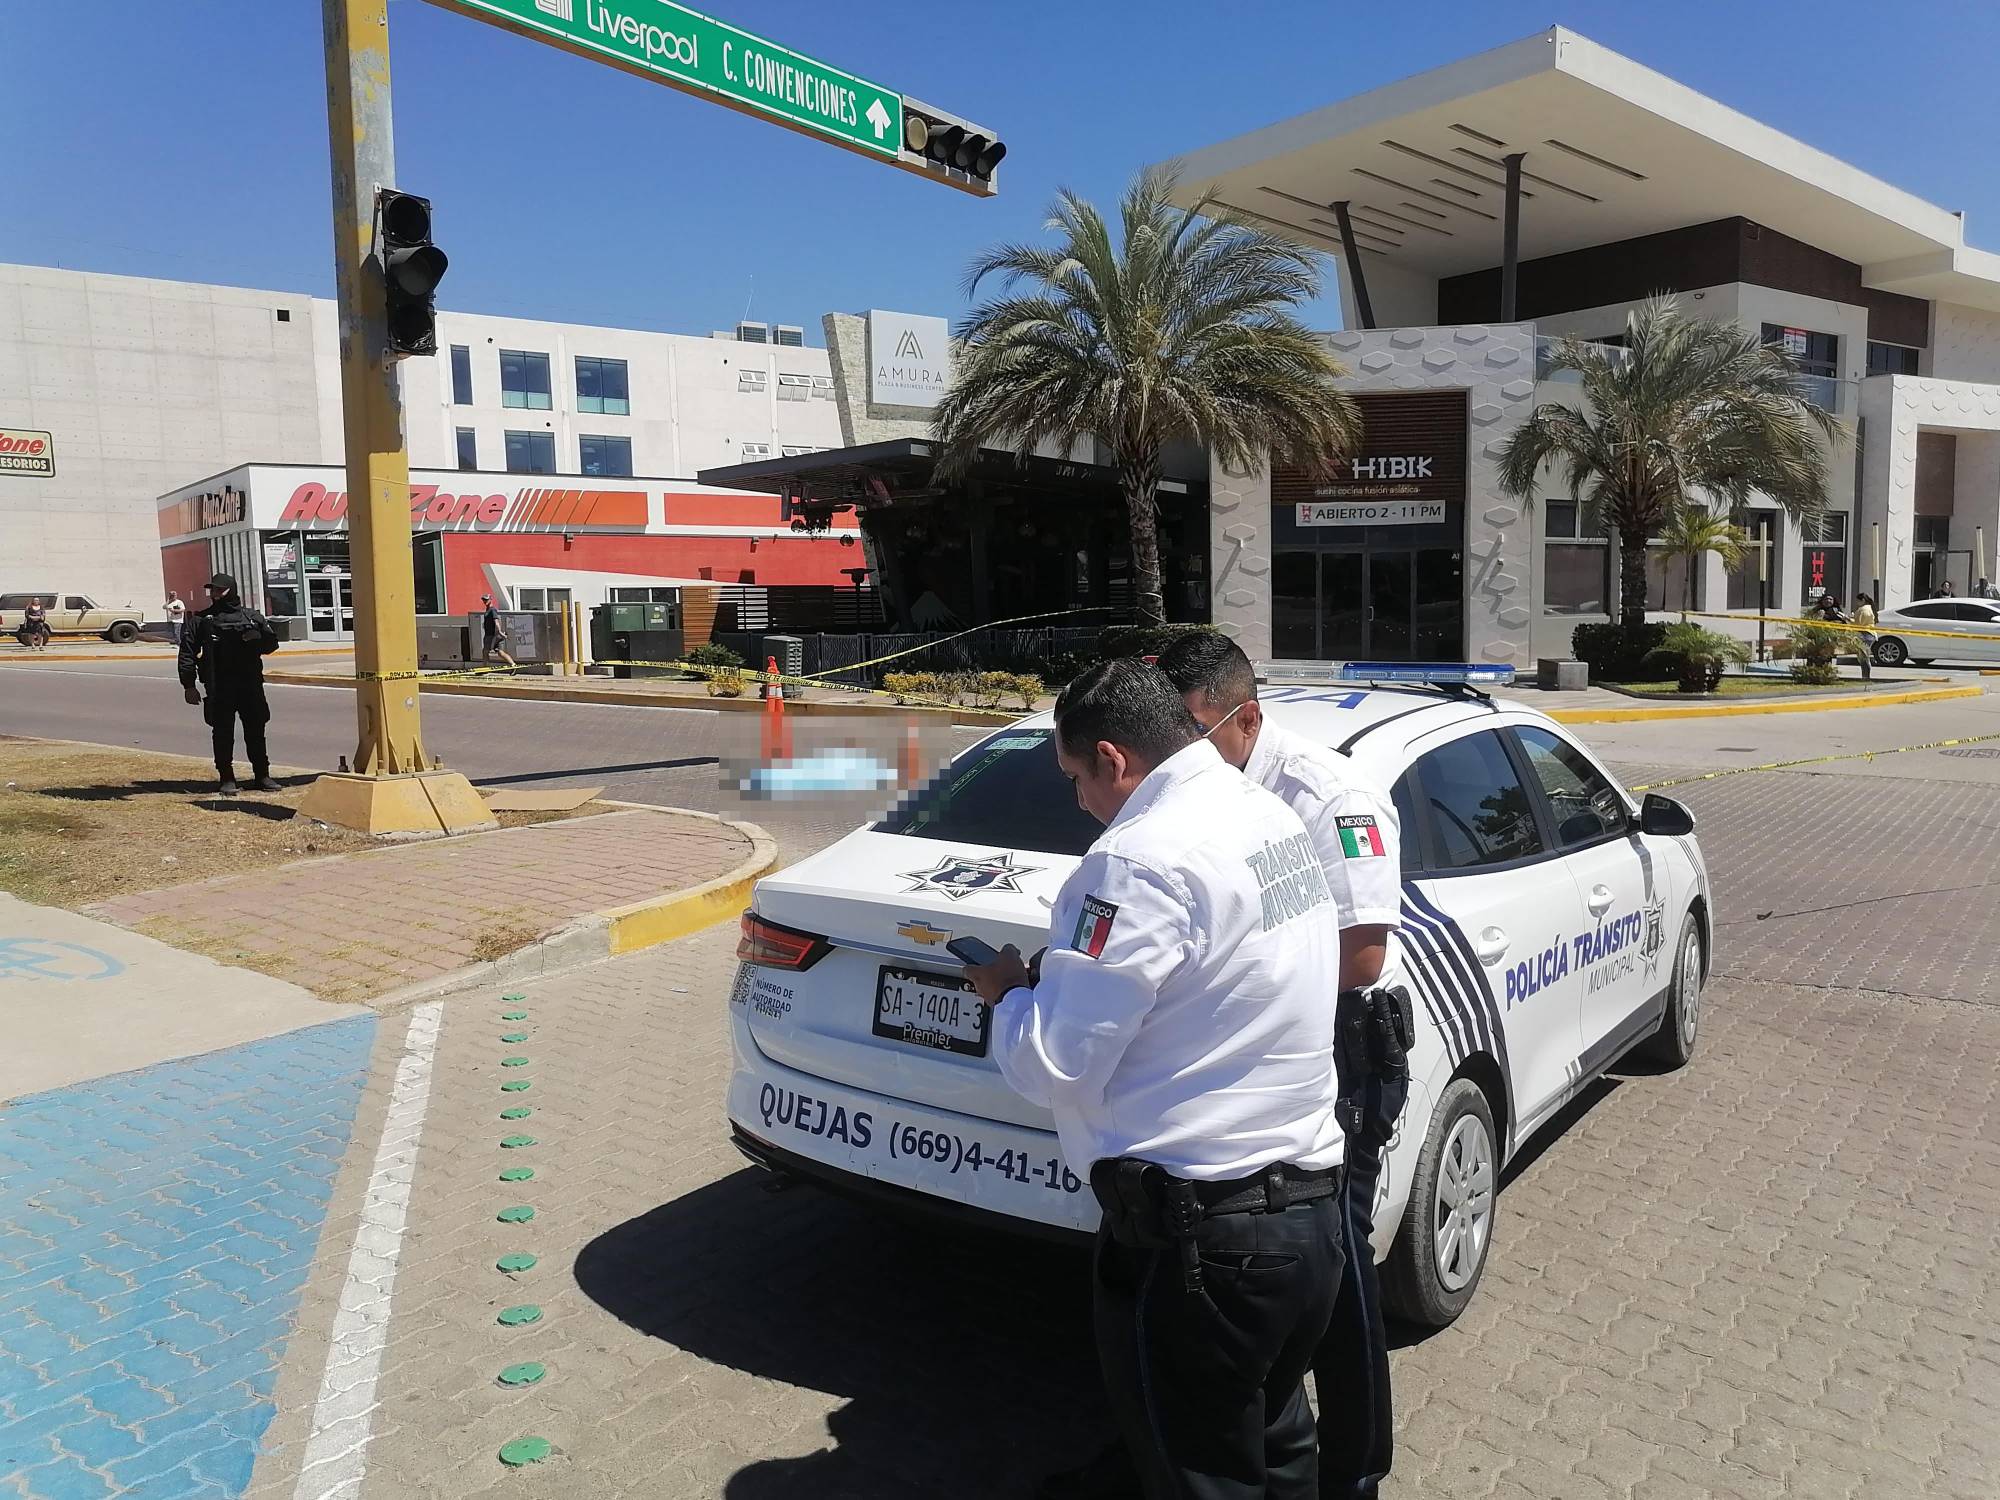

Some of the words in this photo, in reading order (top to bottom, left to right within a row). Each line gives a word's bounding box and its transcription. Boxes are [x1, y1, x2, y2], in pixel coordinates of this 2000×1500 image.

[586, 0, 698, 68] Liverpool
[723, 41, 738, 83] C.
[744, 52, 857, 128] CONVENCIONES
[878, 365, 943, 384] AMURA
[0, 433, 45, 454] one
[1352, 456, 1433, 479] HIBIK
[280, 481, 508, 523] AuZone
[1315, 508, 1377, 519] ABIERTO
[1380, 507, 1389, 518] 2
[1401, 507, 1415, 517] 11
[1420, 506, 1441, 517] PM
[1340, 816, 1373, 828] MEXICO
[1083, 898, 1112, 919] MEXICO
[1505, 933, 1568, 1012] POLICÍA
[1573, 910, 1641, 972] TRÁNSITO
[1588, 952, 1635, 996] MUNICIPAL
[755, 977, 782, 996] NÚMERO
[783, 988, 794, 1000] DE
[751, 991, 792, 1012] AUTORIDAD
[903, 1021, 952, 1048] Premier
[759, 1082, 873, 1149] QUEJAS
